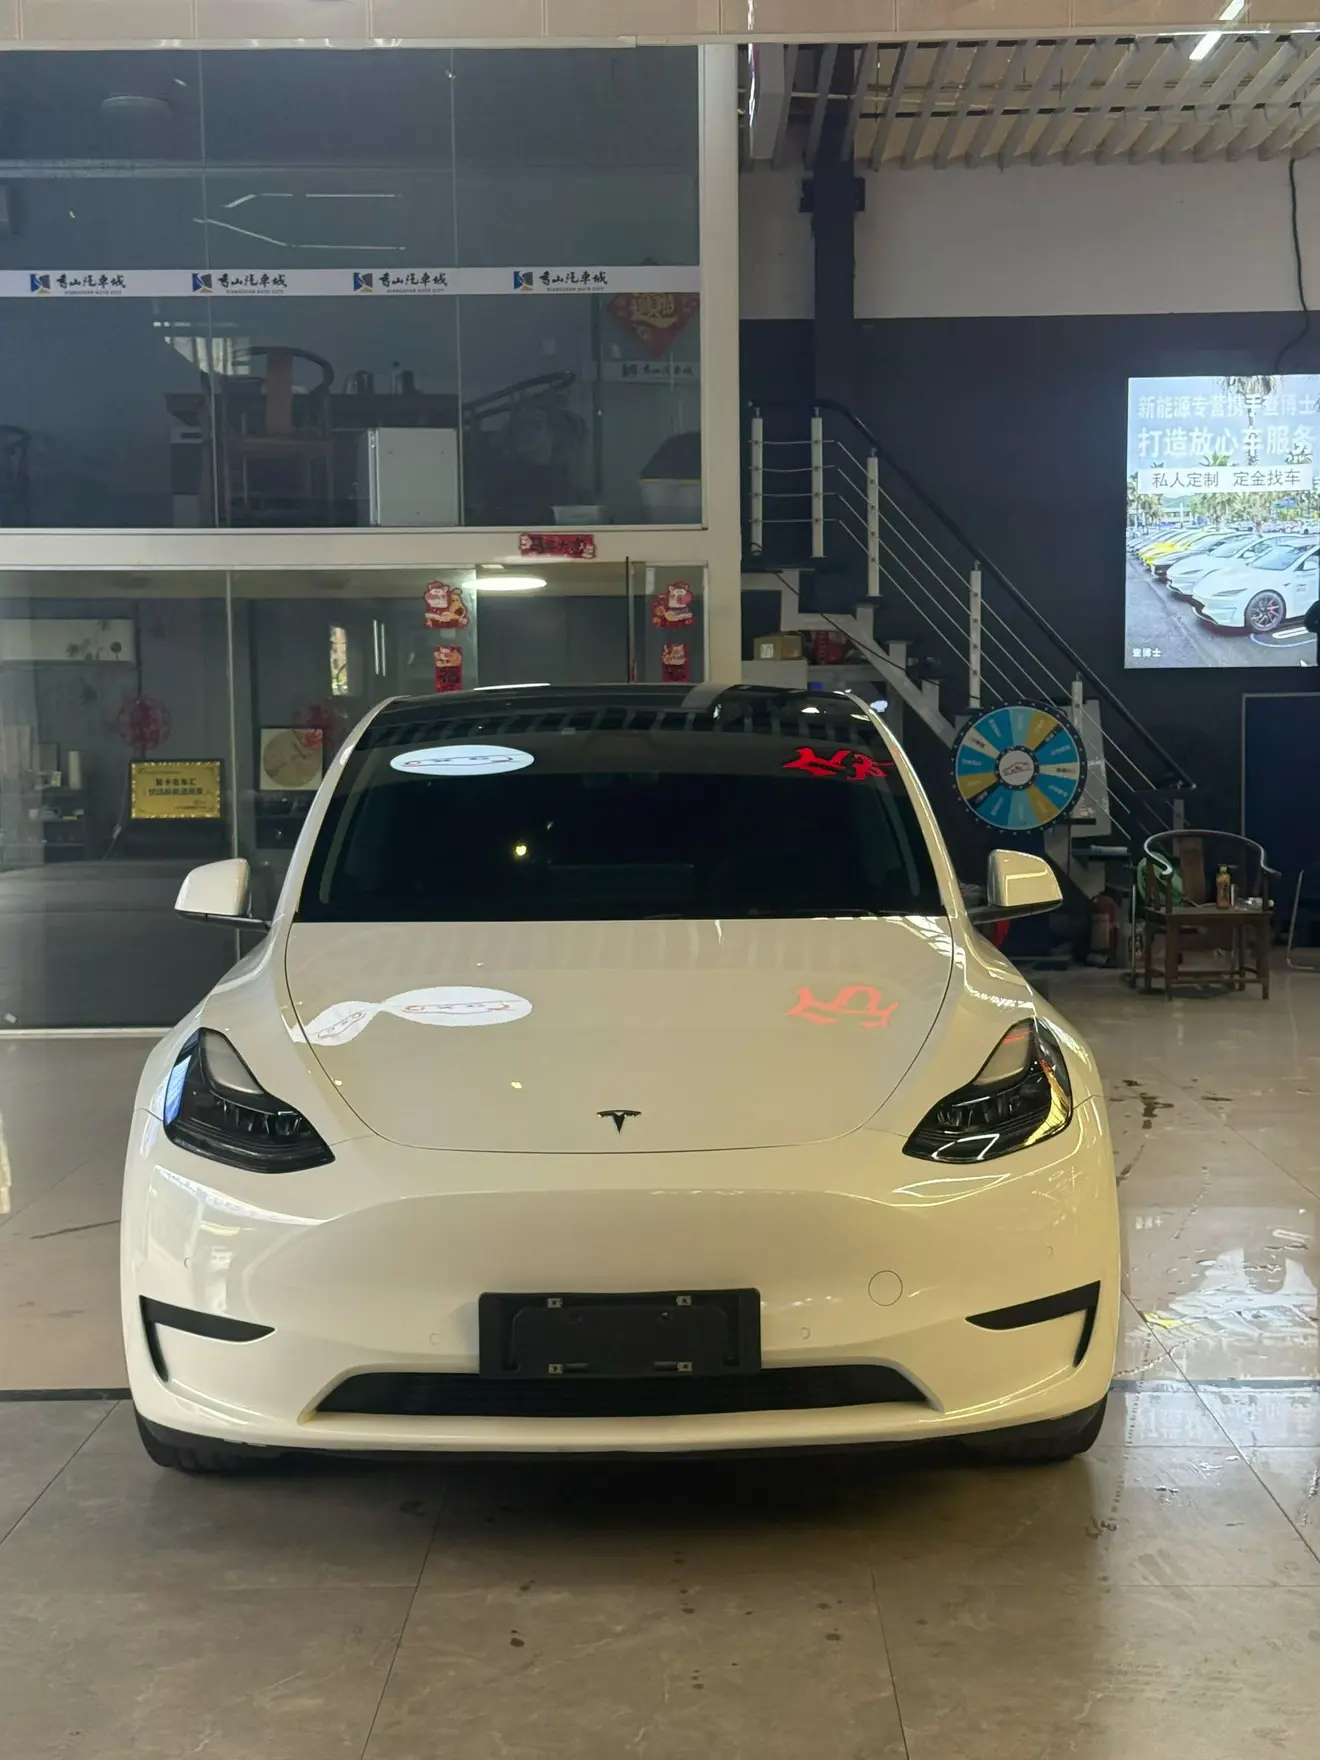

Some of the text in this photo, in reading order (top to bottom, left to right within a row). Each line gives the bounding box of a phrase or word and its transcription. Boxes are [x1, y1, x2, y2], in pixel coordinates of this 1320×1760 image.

[1138, 424, 1315, 457] 打造放心车服务
[1152, 470, 1301, 488] 私人定制 定金找车
